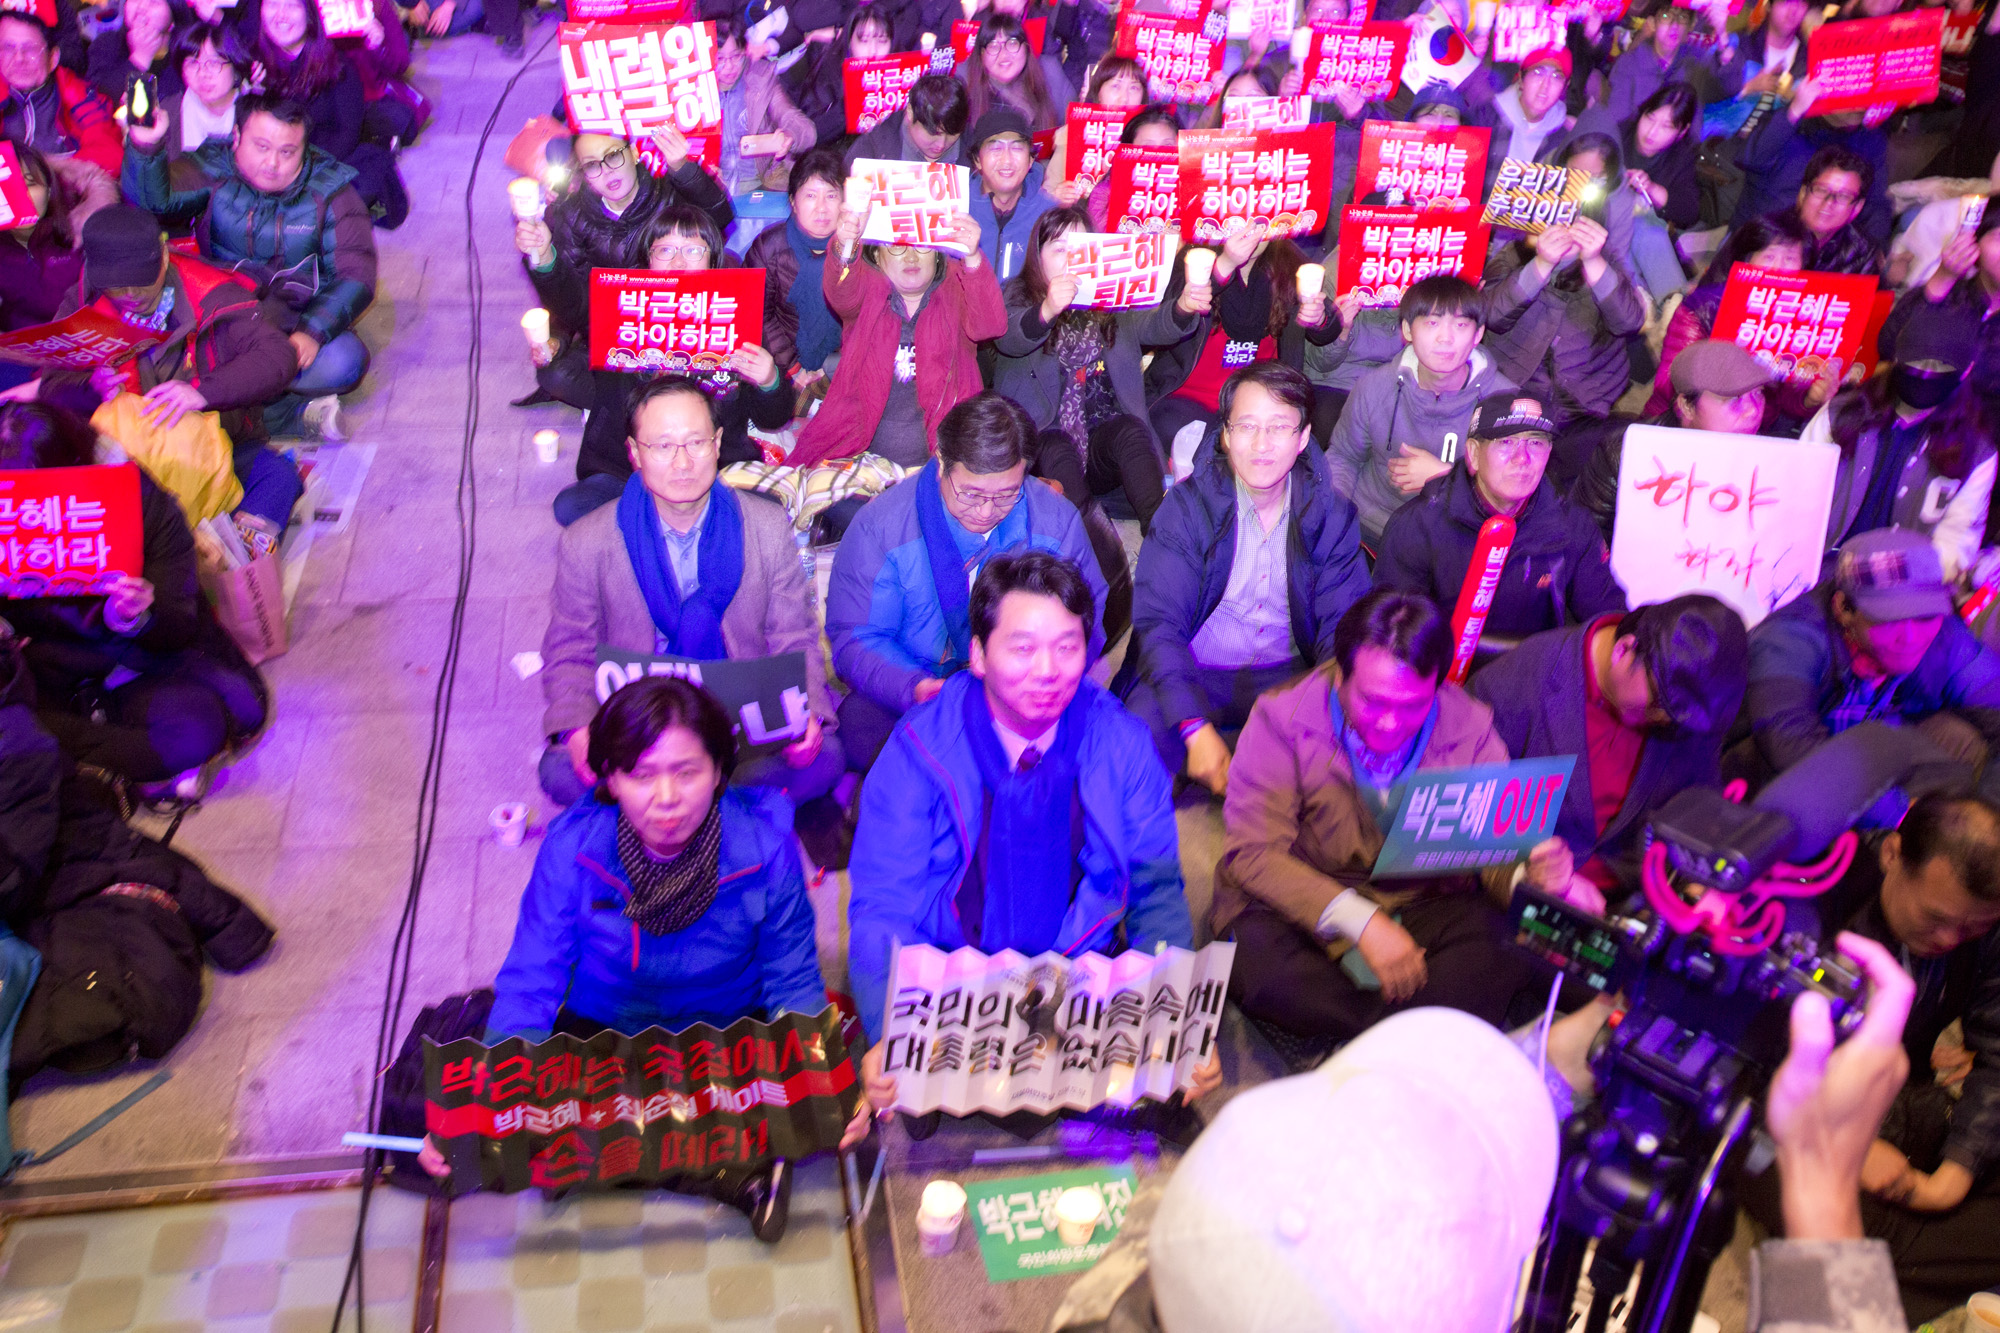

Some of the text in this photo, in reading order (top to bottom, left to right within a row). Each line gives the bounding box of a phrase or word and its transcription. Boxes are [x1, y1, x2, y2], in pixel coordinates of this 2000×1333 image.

[561, 22, 713, 92] 내려와
[1138, 27, 1212, 58] 박근혜는
[1322, 34, 1395, 57] 박근혜는
[1320, 58, 1392, 81] 하야하라
[571, 71, 722, 136] 박근혜
[864, 90, 910, 110] 하야
[1085, 121, 1125, 146] 박근
[1203, 148, 1311, 181] 박근혜는
[1380, 139, 1468, 170] 박근혜는
[1135, 163, 1179, 188] 박근
[1377, 167, 1466, 197] 하야하라
[1497, 165, 1567, 194] 우리가
[1131, 191, 1179, 217] 하야
[1202, 180, 1311, 216] 하야하라
[1489, 193, 1577, 226] 주인이다
[1364, 226, 1467, 255] 박근혜는
[1067, 234, 1165, 279] 박근혜
[1361, 254, 1465, 284] 하야하라
[599, 274, 627, 282] 나눔문화
[1091, 271, 1159, 307] 퇴진
[619, 290, 738, 321] 박근혜는
[1748, 286, 1850, 323] 박근혜는
[618, 321, 738, 351] 하야하라
[1226, 340, 1258, 353] 하야
[1737, 318, 1843, 357] 하야하라
[1223, 353, 1255, 364] 하라
[1633, 455, 1781, 530] 하야
[1402, 773, 1565, 843] 박근혜 OUT
[893, 985, 1015, 1032] 국민의
[1066, 979, 1225, 1031] 마음속에
[1062, 1021, 1215, 1074] 없습니다
[441, 1027, 824, 1103] 박근혜는 국정에서
[494, 1098, 582, 1136] 박근혜
[703, 1079, 788, 1114] 게이트
[529, 1131, 645, 1189] 손을
